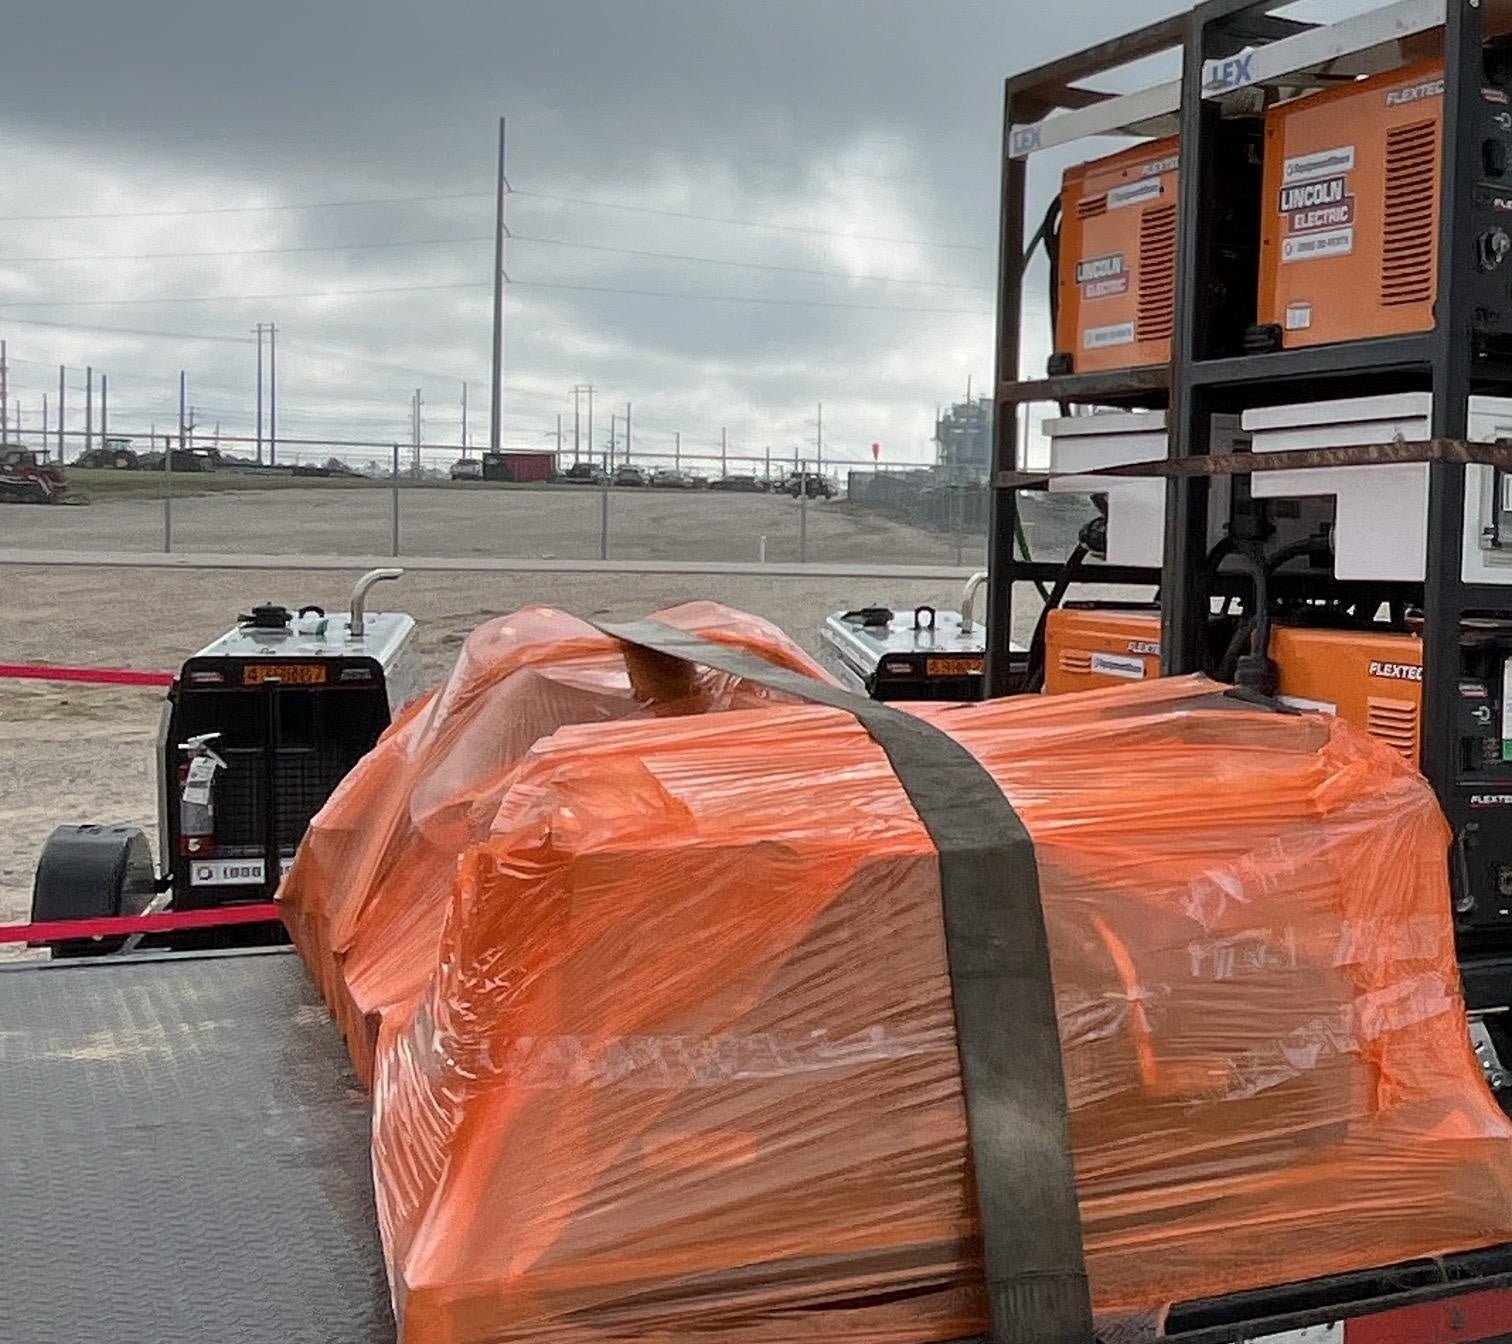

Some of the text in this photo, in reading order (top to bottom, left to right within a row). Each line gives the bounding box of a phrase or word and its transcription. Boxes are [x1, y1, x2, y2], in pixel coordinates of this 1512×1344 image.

[1386, 80, 1446, 107] FLEXTEC
[1280, 179, 1344, 212] LINCOLN
[1294, 206, 1349, 230] ELECTRIC
[1369, 660, 1423, 681] FLEXTEC
